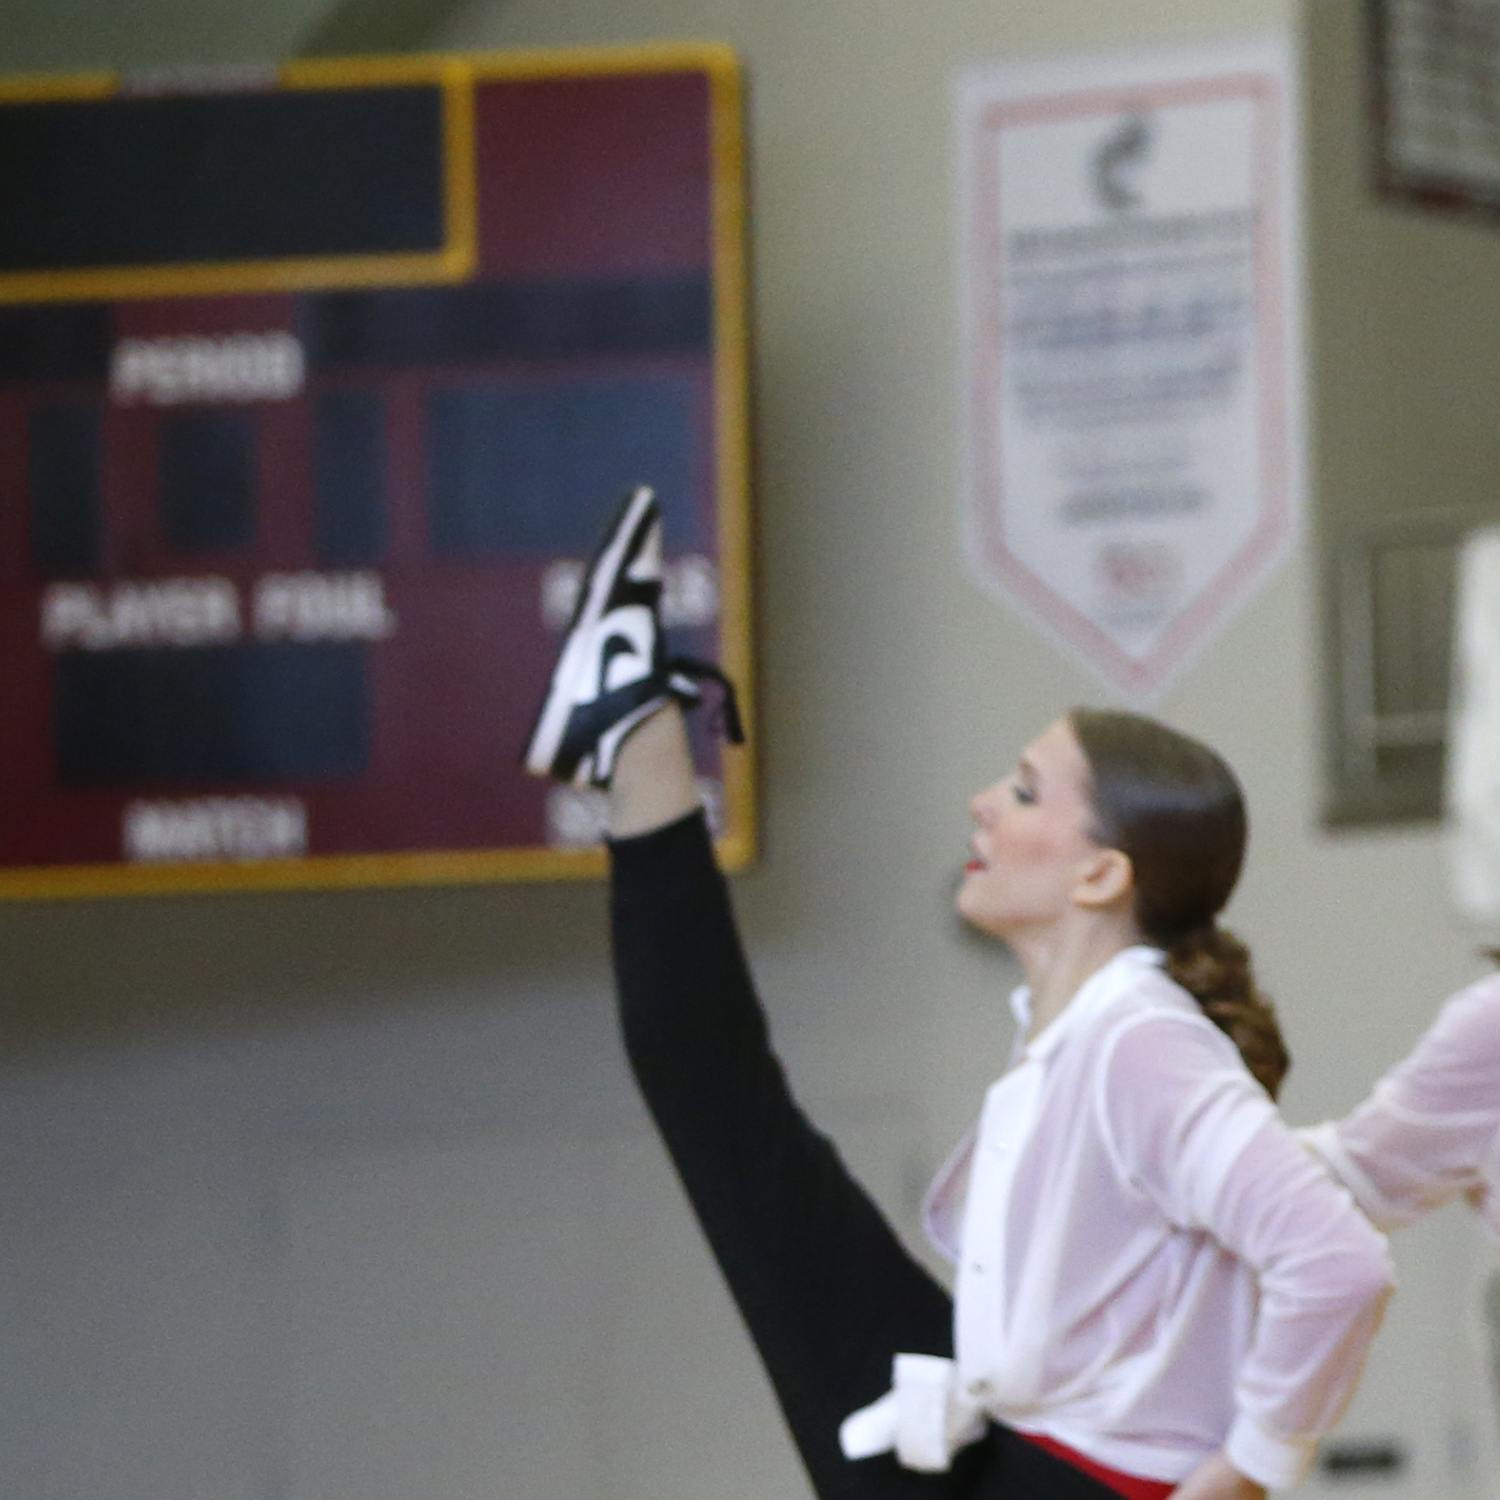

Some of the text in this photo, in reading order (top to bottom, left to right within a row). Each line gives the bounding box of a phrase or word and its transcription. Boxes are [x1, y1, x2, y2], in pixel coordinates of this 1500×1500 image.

[113, 335, 302, 401] PERIOD
[43, 572, 394, 646] PLAYER FOUL
